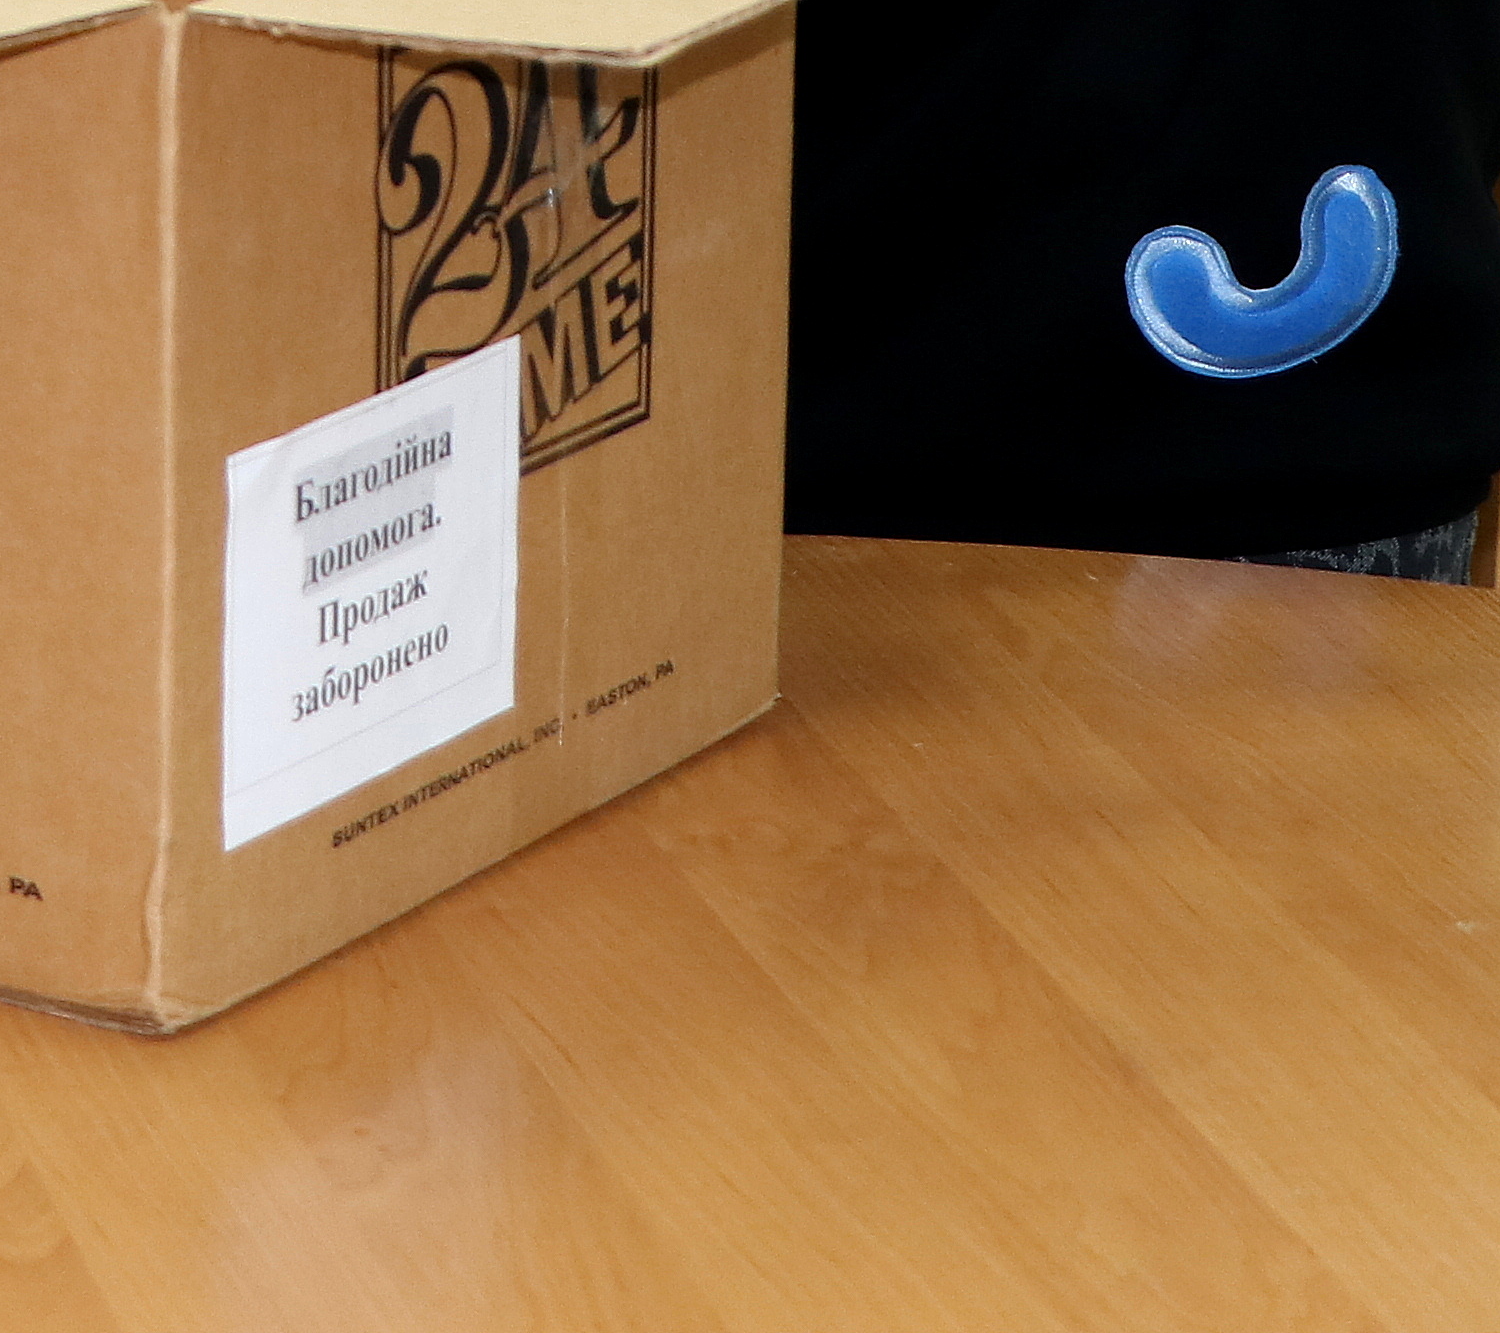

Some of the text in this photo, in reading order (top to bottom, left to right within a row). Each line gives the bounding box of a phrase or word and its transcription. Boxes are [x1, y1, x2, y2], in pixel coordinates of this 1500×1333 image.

[379, 57, 643, 377] 24
[293, 428, 454, 524] Благодійна
[302, 501, 442, 589] допомога.
[316, 571, 429, 647] Продаж
[290, 623, 450, 723] заборонено
[330, 797, 399, 848] SUNTEX
[401, 732, 530, 816] INTERNATIONAL,
[585, 677, 652, 720] EASTON,
[654, 658, 676, 681] PA
[7, 874, 44, 901] PA
